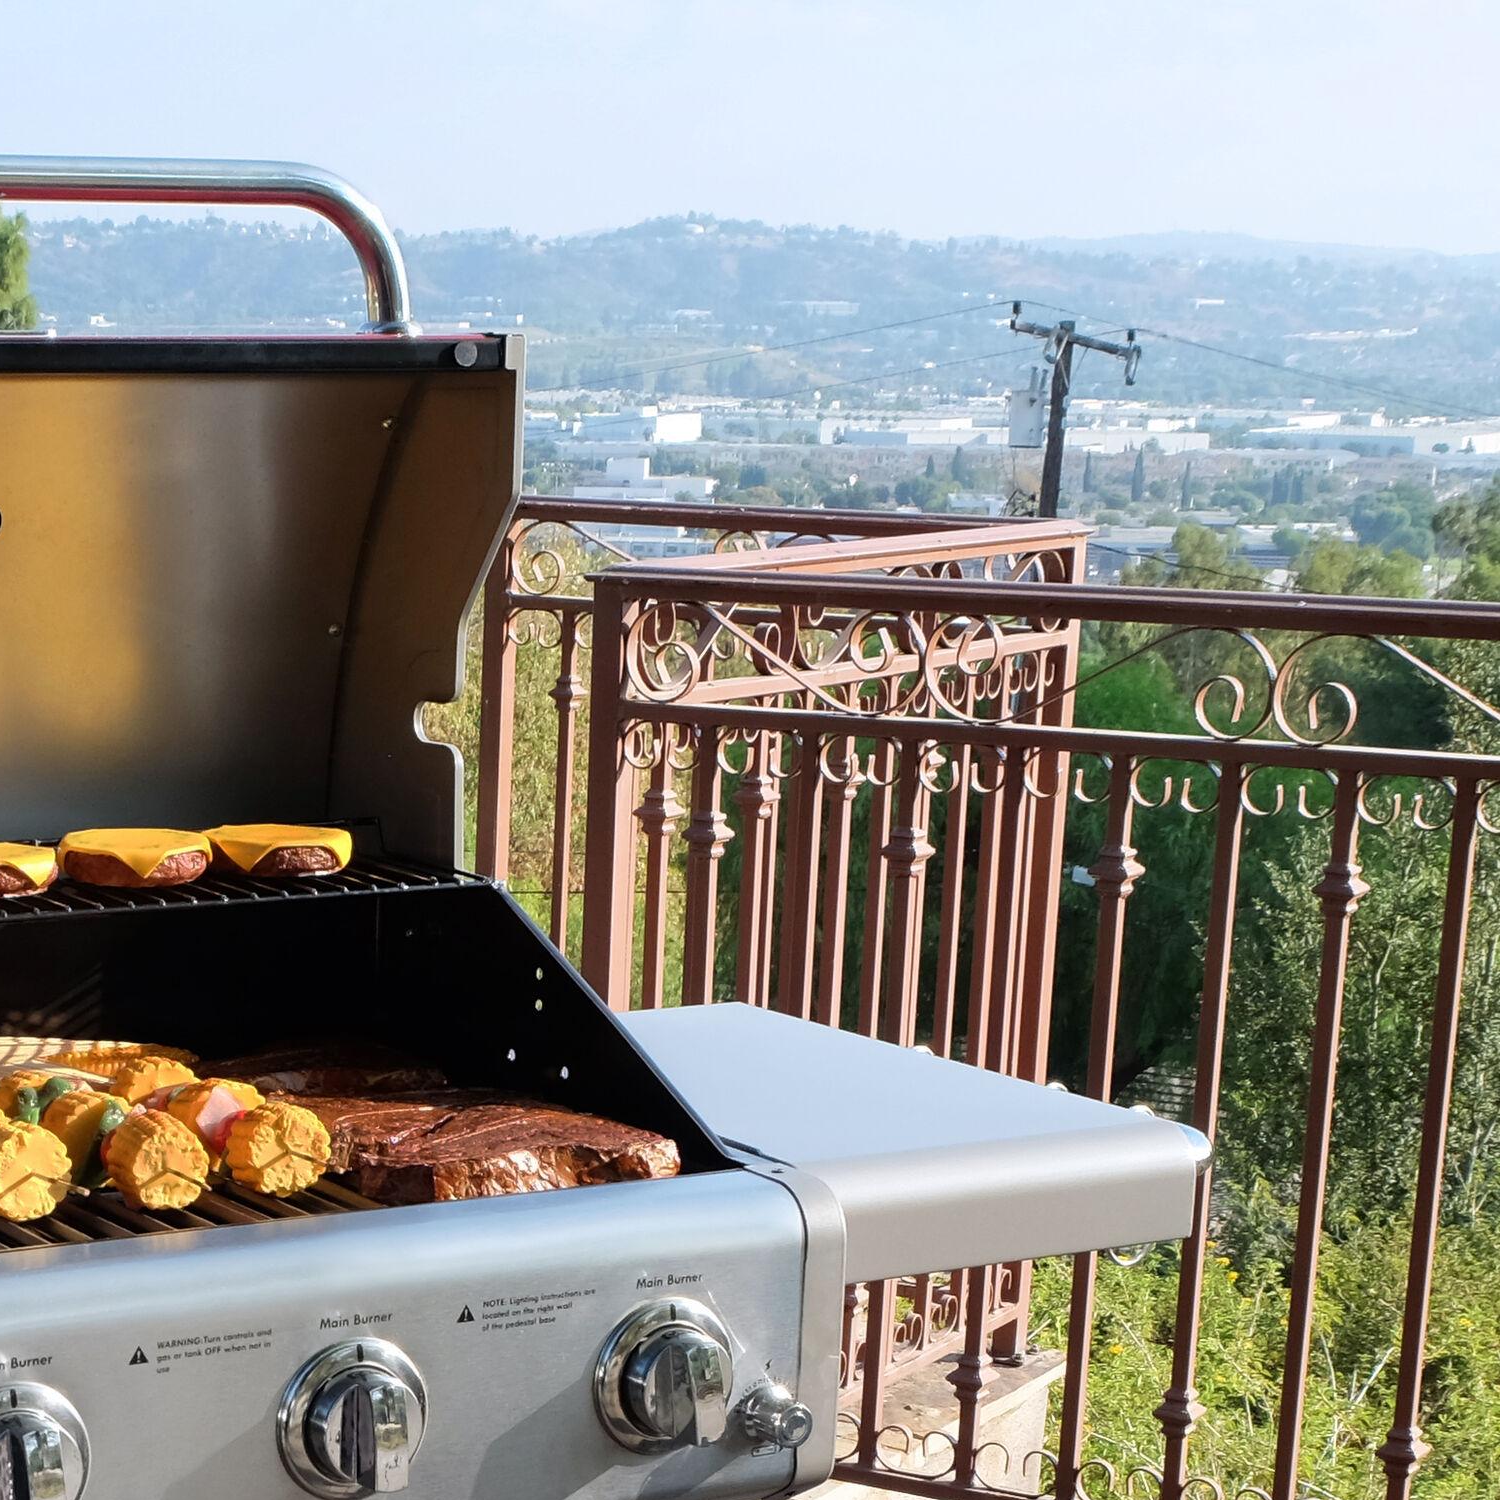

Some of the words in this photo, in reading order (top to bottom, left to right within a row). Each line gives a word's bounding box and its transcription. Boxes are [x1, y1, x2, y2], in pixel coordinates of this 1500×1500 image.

[636, 1277, 663, 1289] Main
[667, 1274, 703, 1285] Burner
[541, 1291, 582, 1301] instructions
[482, 1309, 509, 1319] located
[537, 1304, 554, 1313] right
[557, 1301, 573, 1310] wall
[320, 1316, 349, 1330] Main
[354, 1313, 393, 1326] Burner
[505, 1318, 537, 1329] pedestal
[539, 1316, 556, 1324] base
[223, 1332, 254, 1341] controls
[256, 1328, 272, 1336] and
[156, 1355, 171, 1363] gas
[184, 1350, 202, 1358] tank
[204, 1346, 221, 1356] OFF
[224, 1344, 246, 1353] when
[10, 1356, 53, 1369] Burner
[156, 1366, 170, 1374] use
